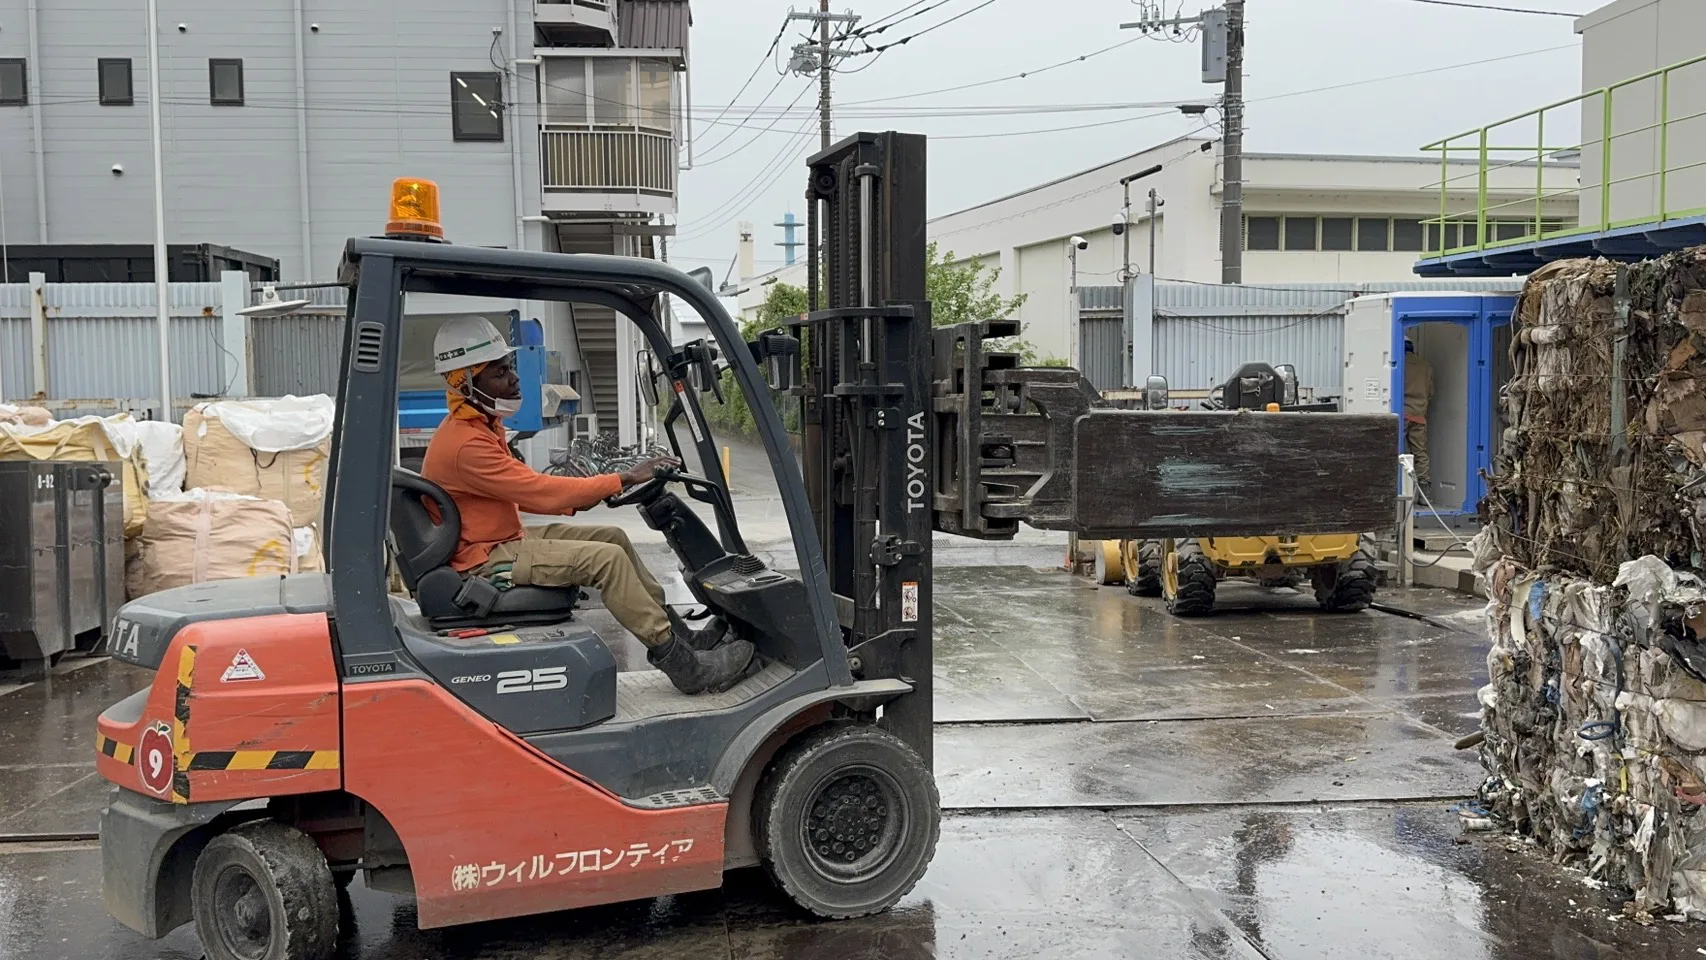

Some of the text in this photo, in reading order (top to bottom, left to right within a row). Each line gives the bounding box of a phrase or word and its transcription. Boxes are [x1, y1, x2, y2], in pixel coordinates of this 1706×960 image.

[907, 411, 925, 514] TOYOTA
[351, 663, 393, 674] TOYOTA
[451, 666, 568, 695] GENEO 25
[149, 748, 163, 779] 9
